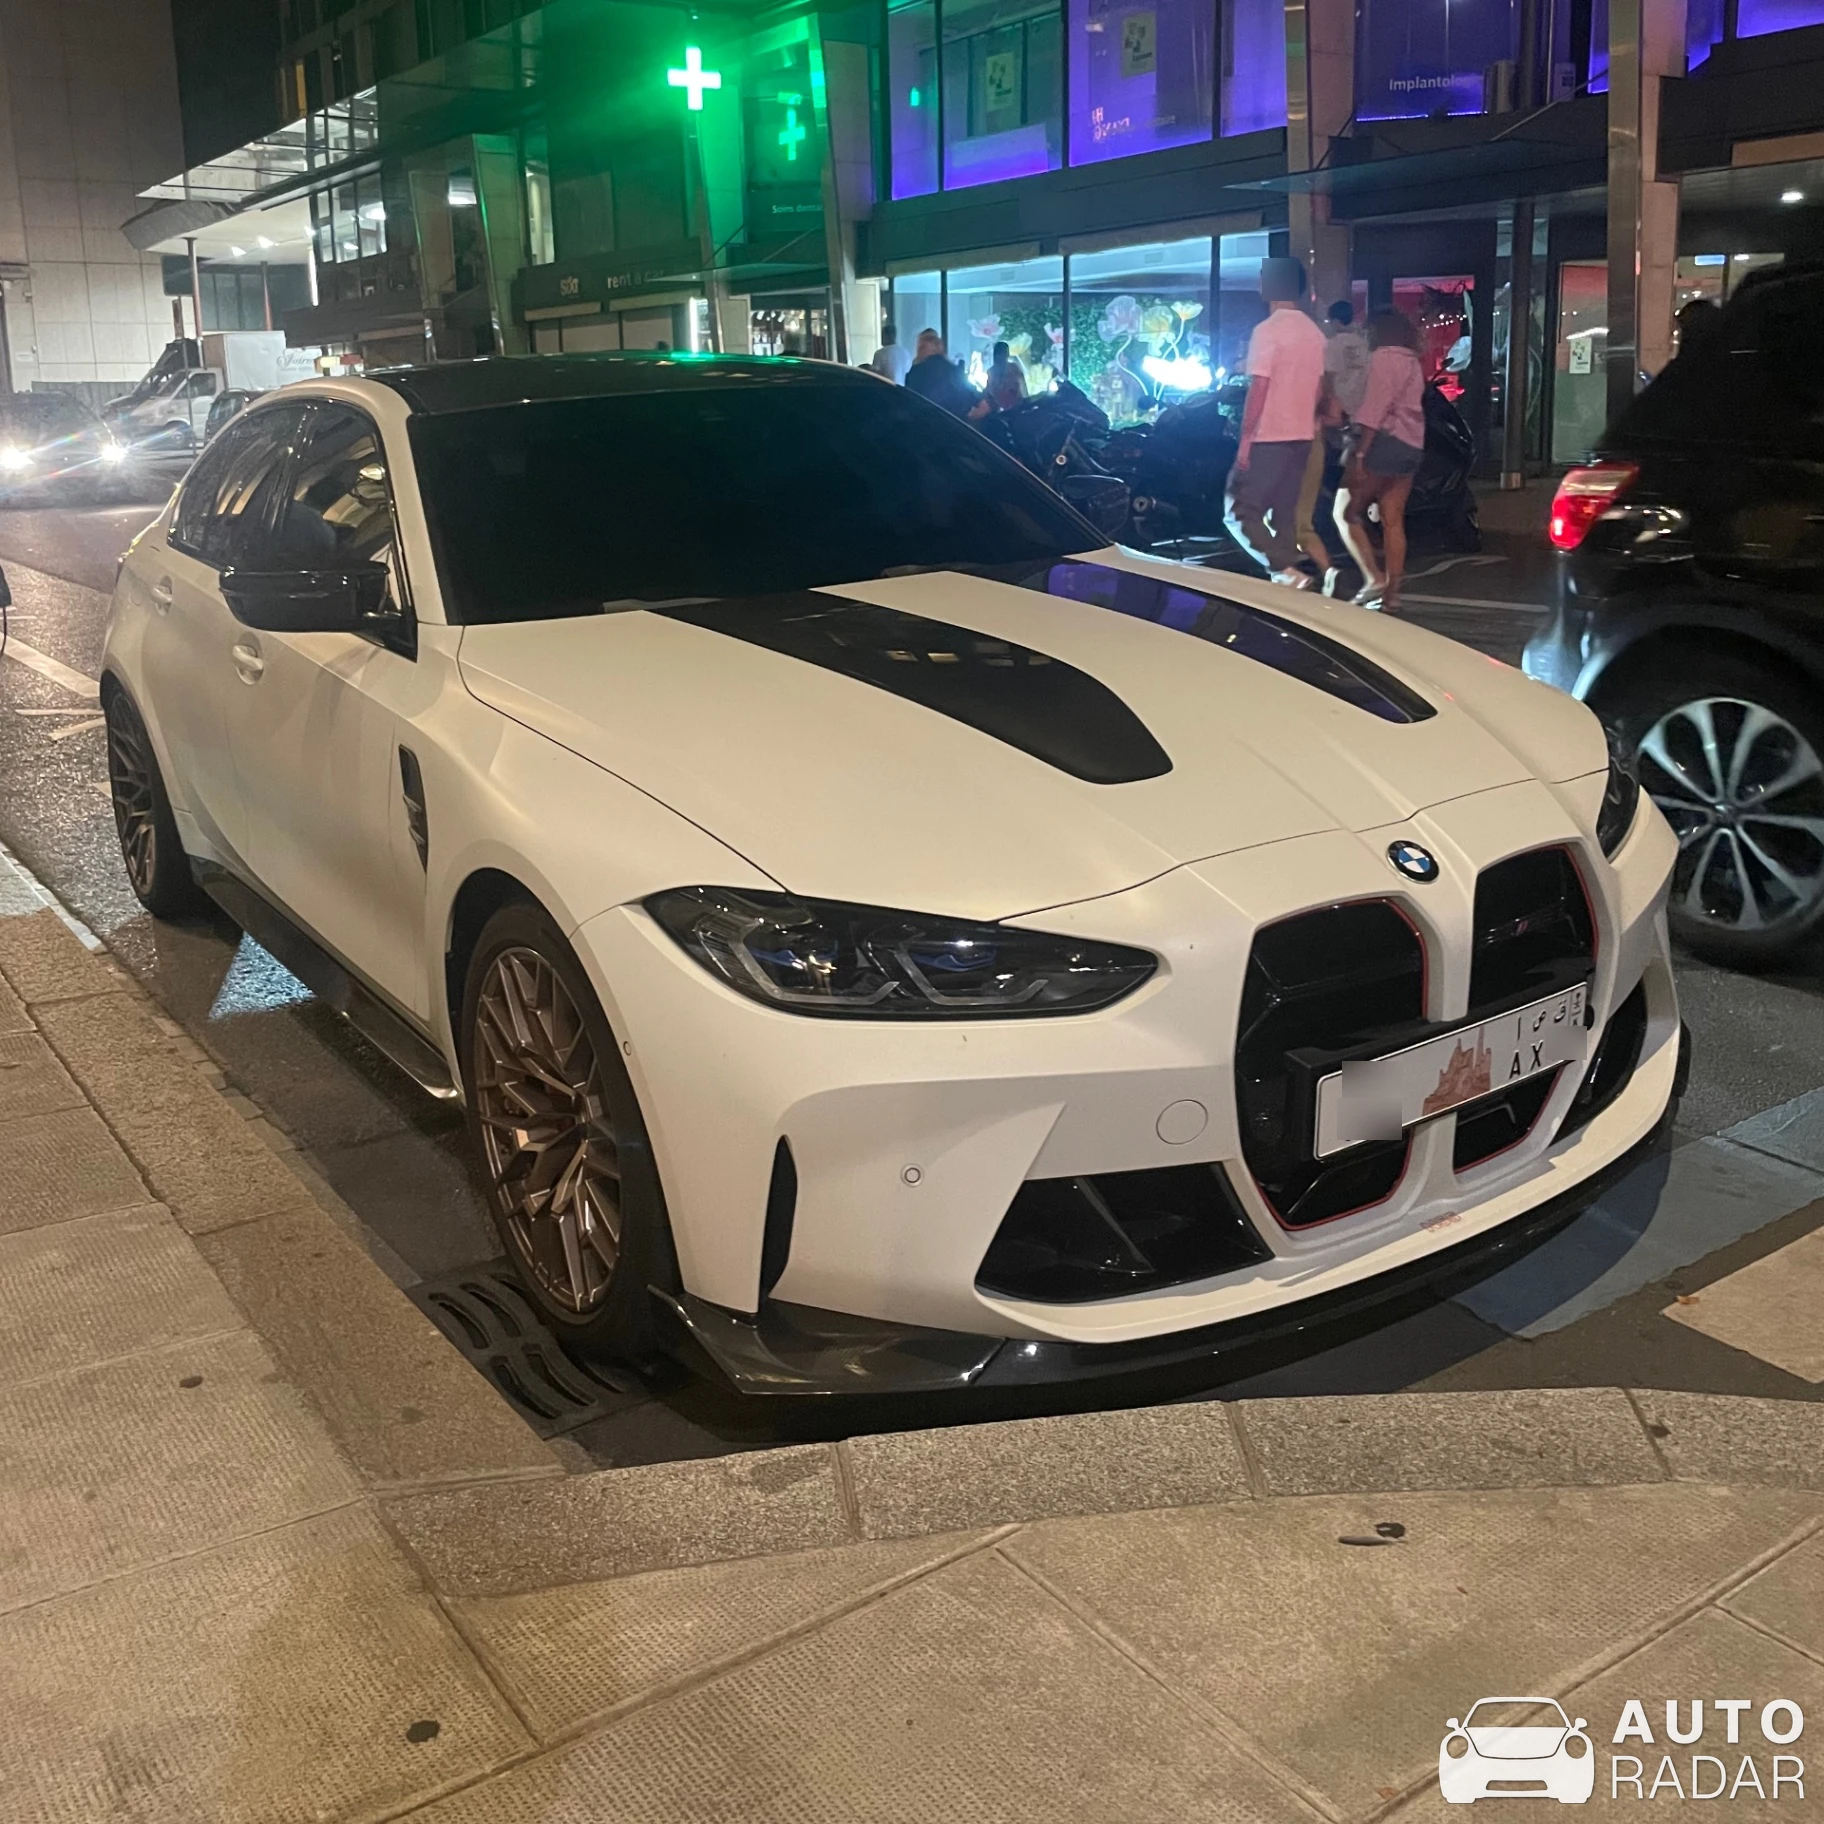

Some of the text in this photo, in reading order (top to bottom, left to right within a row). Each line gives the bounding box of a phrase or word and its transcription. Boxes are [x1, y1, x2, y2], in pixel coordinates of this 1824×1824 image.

[607, 273, 631, 289] rent
[635, 275, 642, 285] a
[644, 269, 664, 283] car
